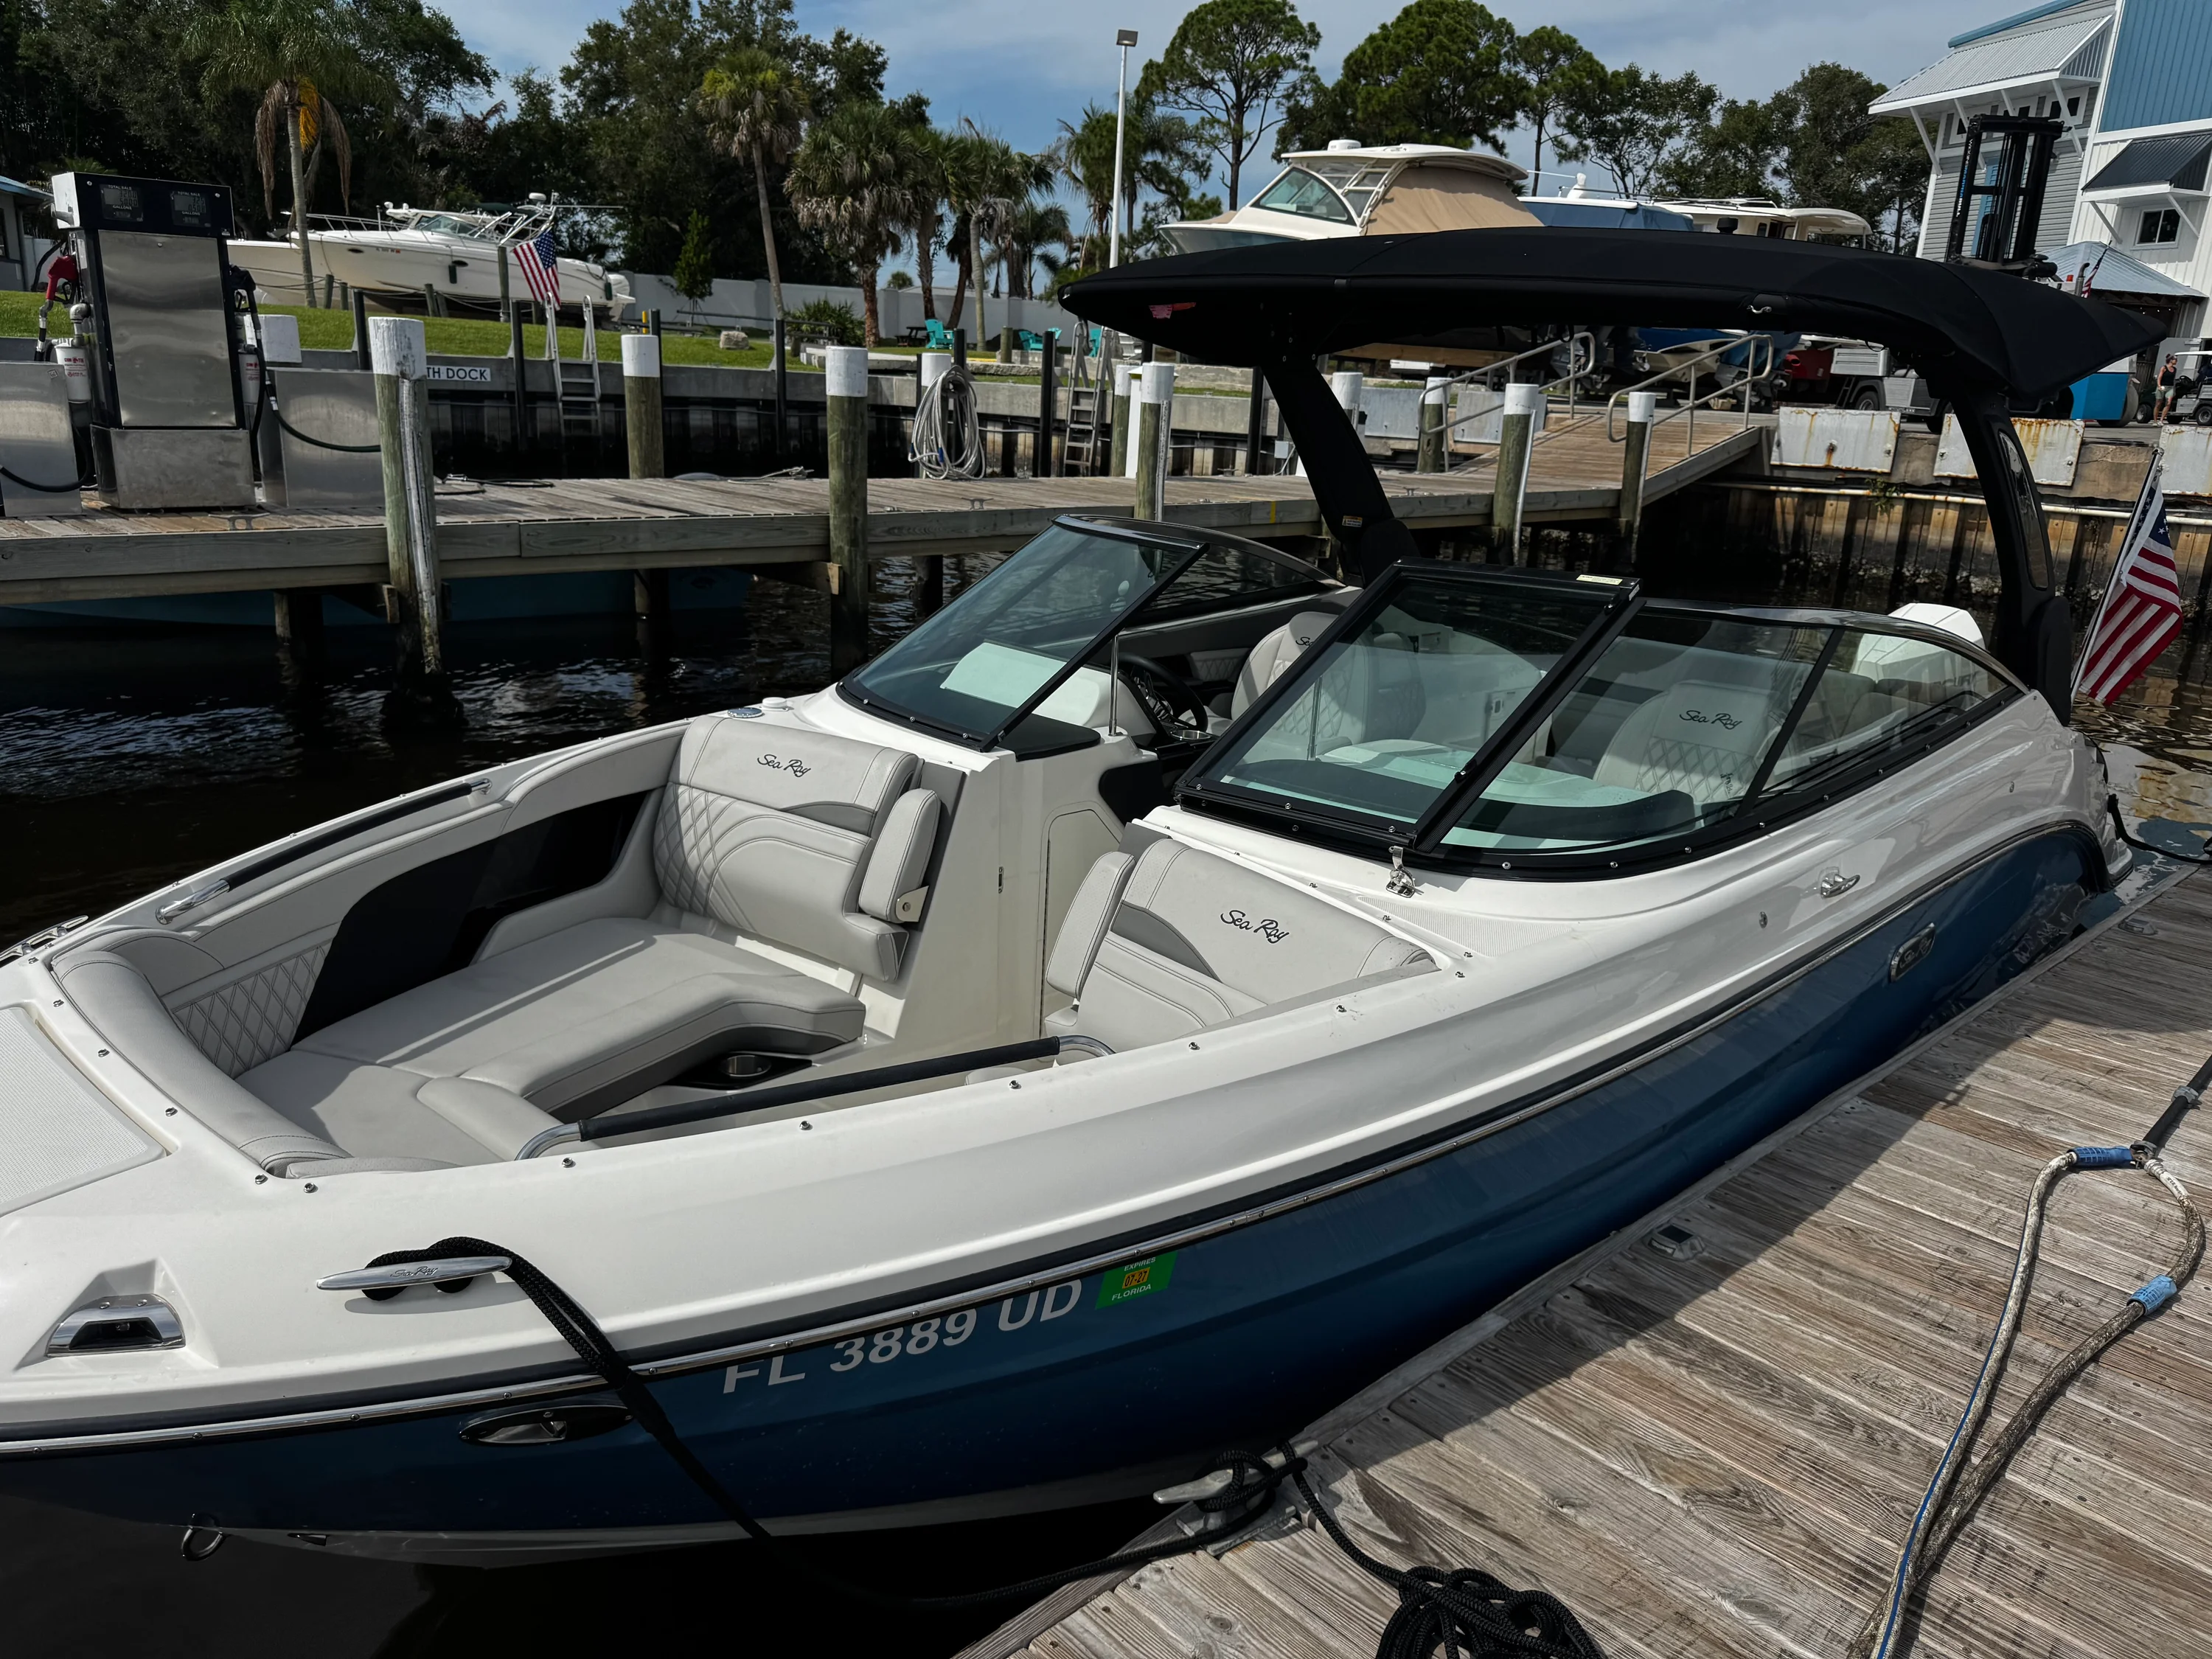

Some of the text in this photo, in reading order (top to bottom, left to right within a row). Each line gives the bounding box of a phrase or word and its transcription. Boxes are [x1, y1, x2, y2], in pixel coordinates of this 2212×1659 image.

[446, 367, 487, 380] DOCK
[1679, 710, 1743, 730] Sea Ray
[757, 754, 811, 777] Sea Ray
[1220, 910, 1290, 944] Sea Ray
[390, 1265, 439, 1277] Sea Ray
[1124, 1256, 1156, 1271] EXPIRES
[1124, 1270, 1148, 1287] 07-27
[1111, 1284, 1151, 1301] FLORIDA
[723, 1279, 1082, 1394] FL 3889 UD
